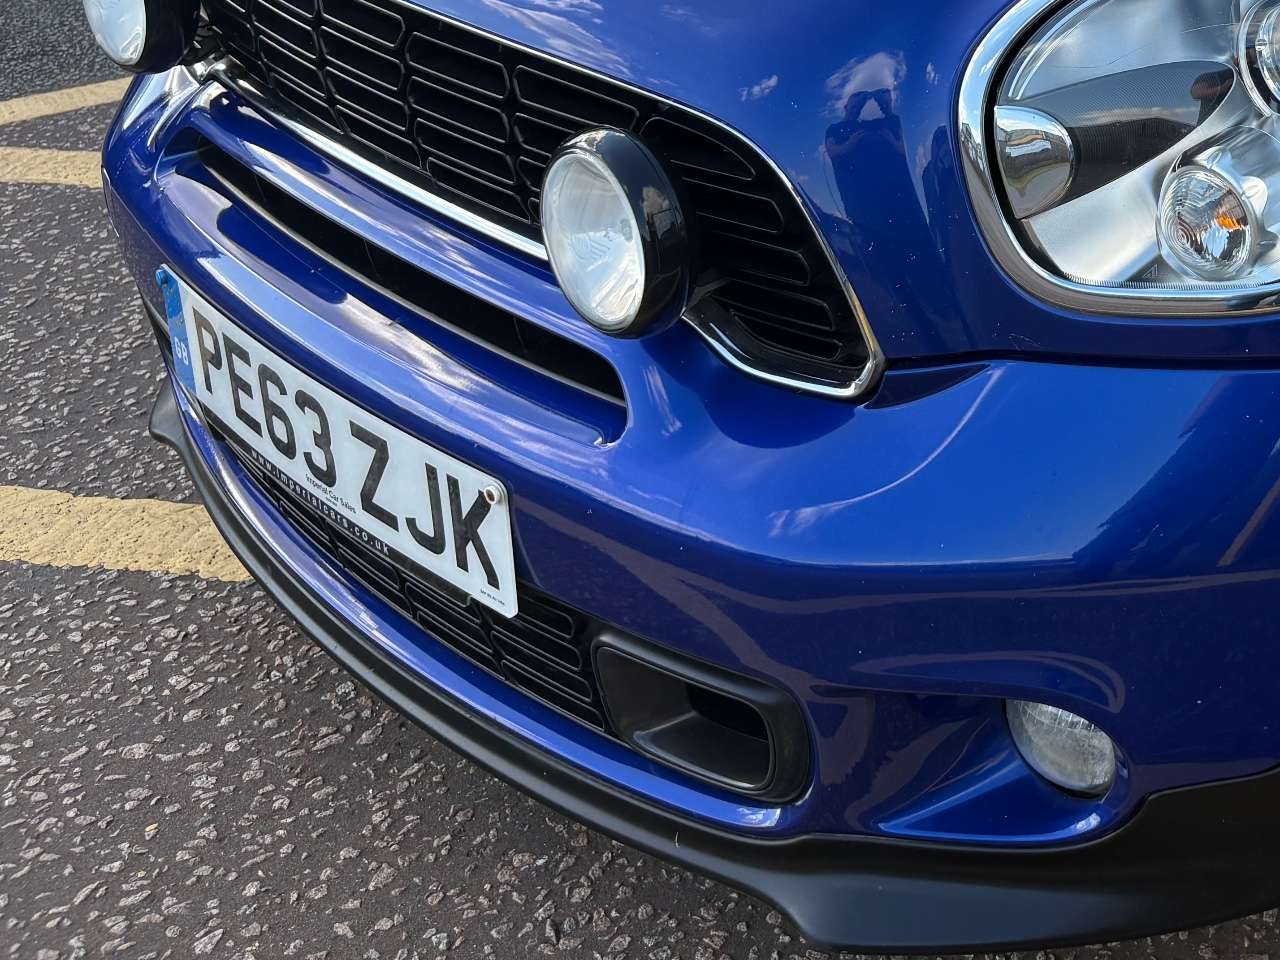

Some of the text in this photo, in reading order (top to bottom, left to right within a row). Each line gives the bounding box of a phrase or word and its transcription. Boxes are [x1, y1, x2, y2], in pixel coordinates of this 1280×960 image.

[174, 336, 190, 367] GB
[192, 306, 501, 591] PE63 ZJK
[250, 448, 391, 556] www.imperialcars.co.uk
